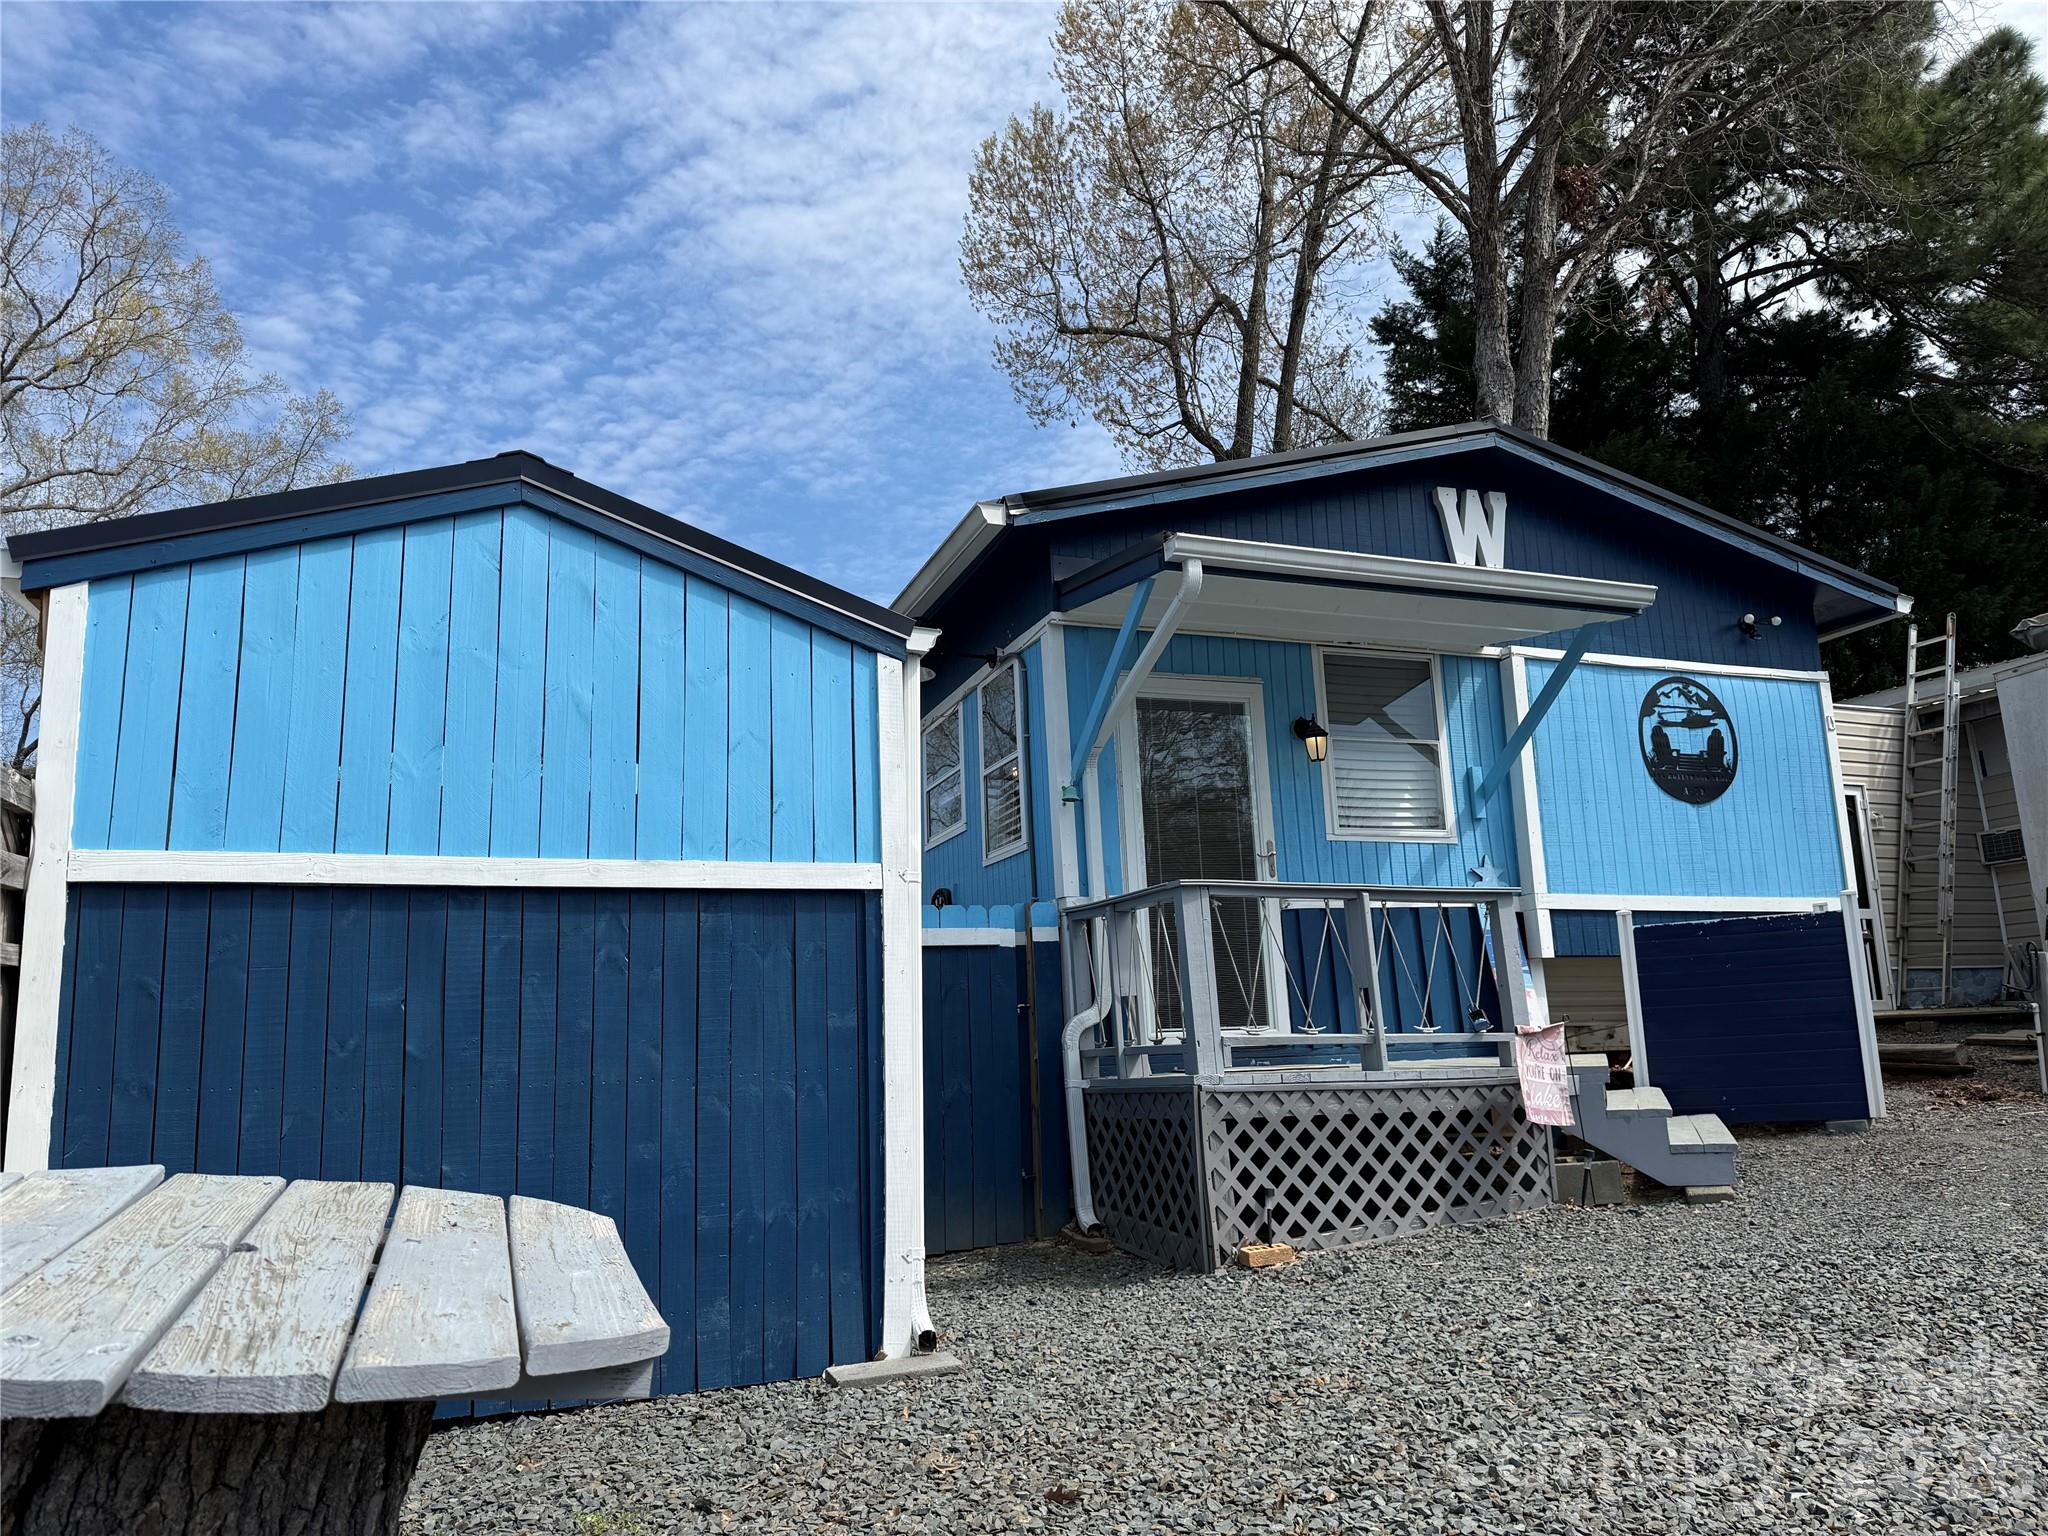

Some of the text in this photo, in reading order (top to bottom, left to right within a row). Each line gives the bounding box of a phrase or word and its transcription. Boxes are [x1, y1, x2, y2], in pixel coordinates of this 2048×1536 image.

[1432, 486, 1507, 568] W
[1526, 1037, 1559, 1060] Relax
[1549, 1066, 1561, 1081] ON
